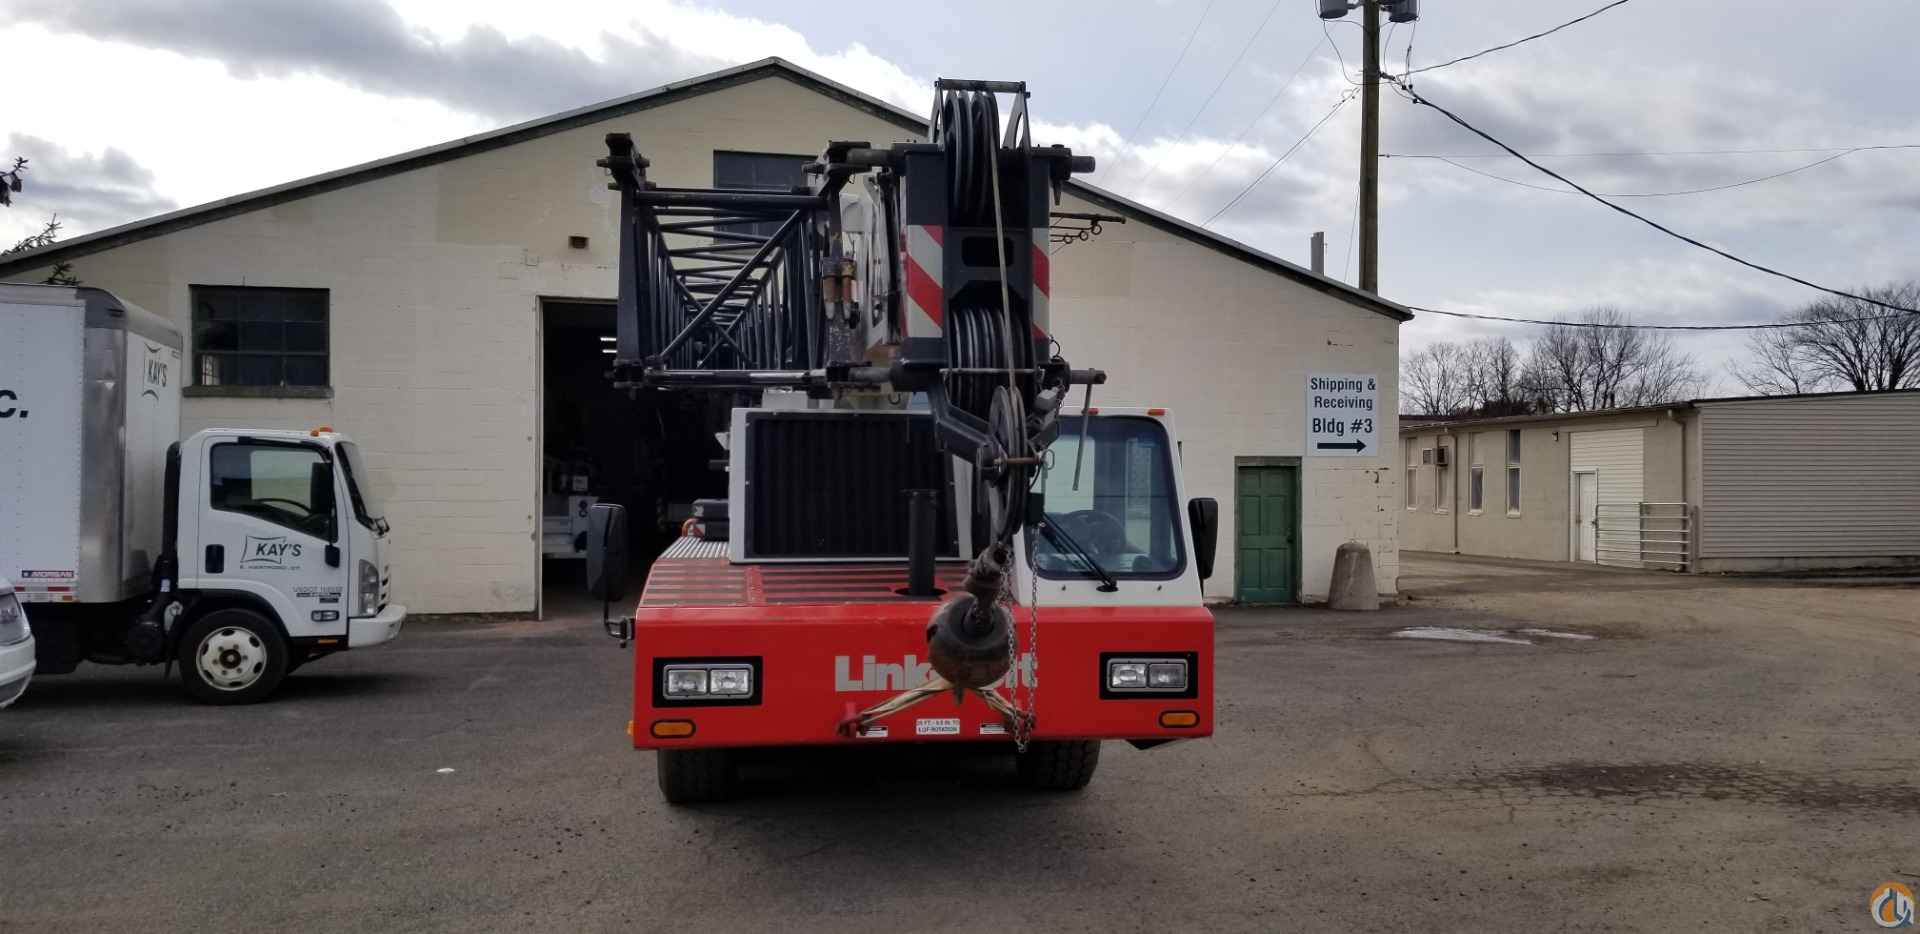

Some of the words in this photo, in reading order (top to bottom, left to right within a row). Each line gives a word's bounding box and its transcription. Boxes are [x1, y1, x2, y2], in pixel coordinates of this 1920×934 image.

[148, 360, 168, 387] KAY'S
[1310, 378, 1363, 392] Shipping
[1367, 378, 1376, 390] &
[1314, 396, 1373, 411] Receiving
[1312, 418, 1345, 436] Bldg
[1350, 418, 1373, 434] #3
[255, 543, 302, 557] KAY'S
